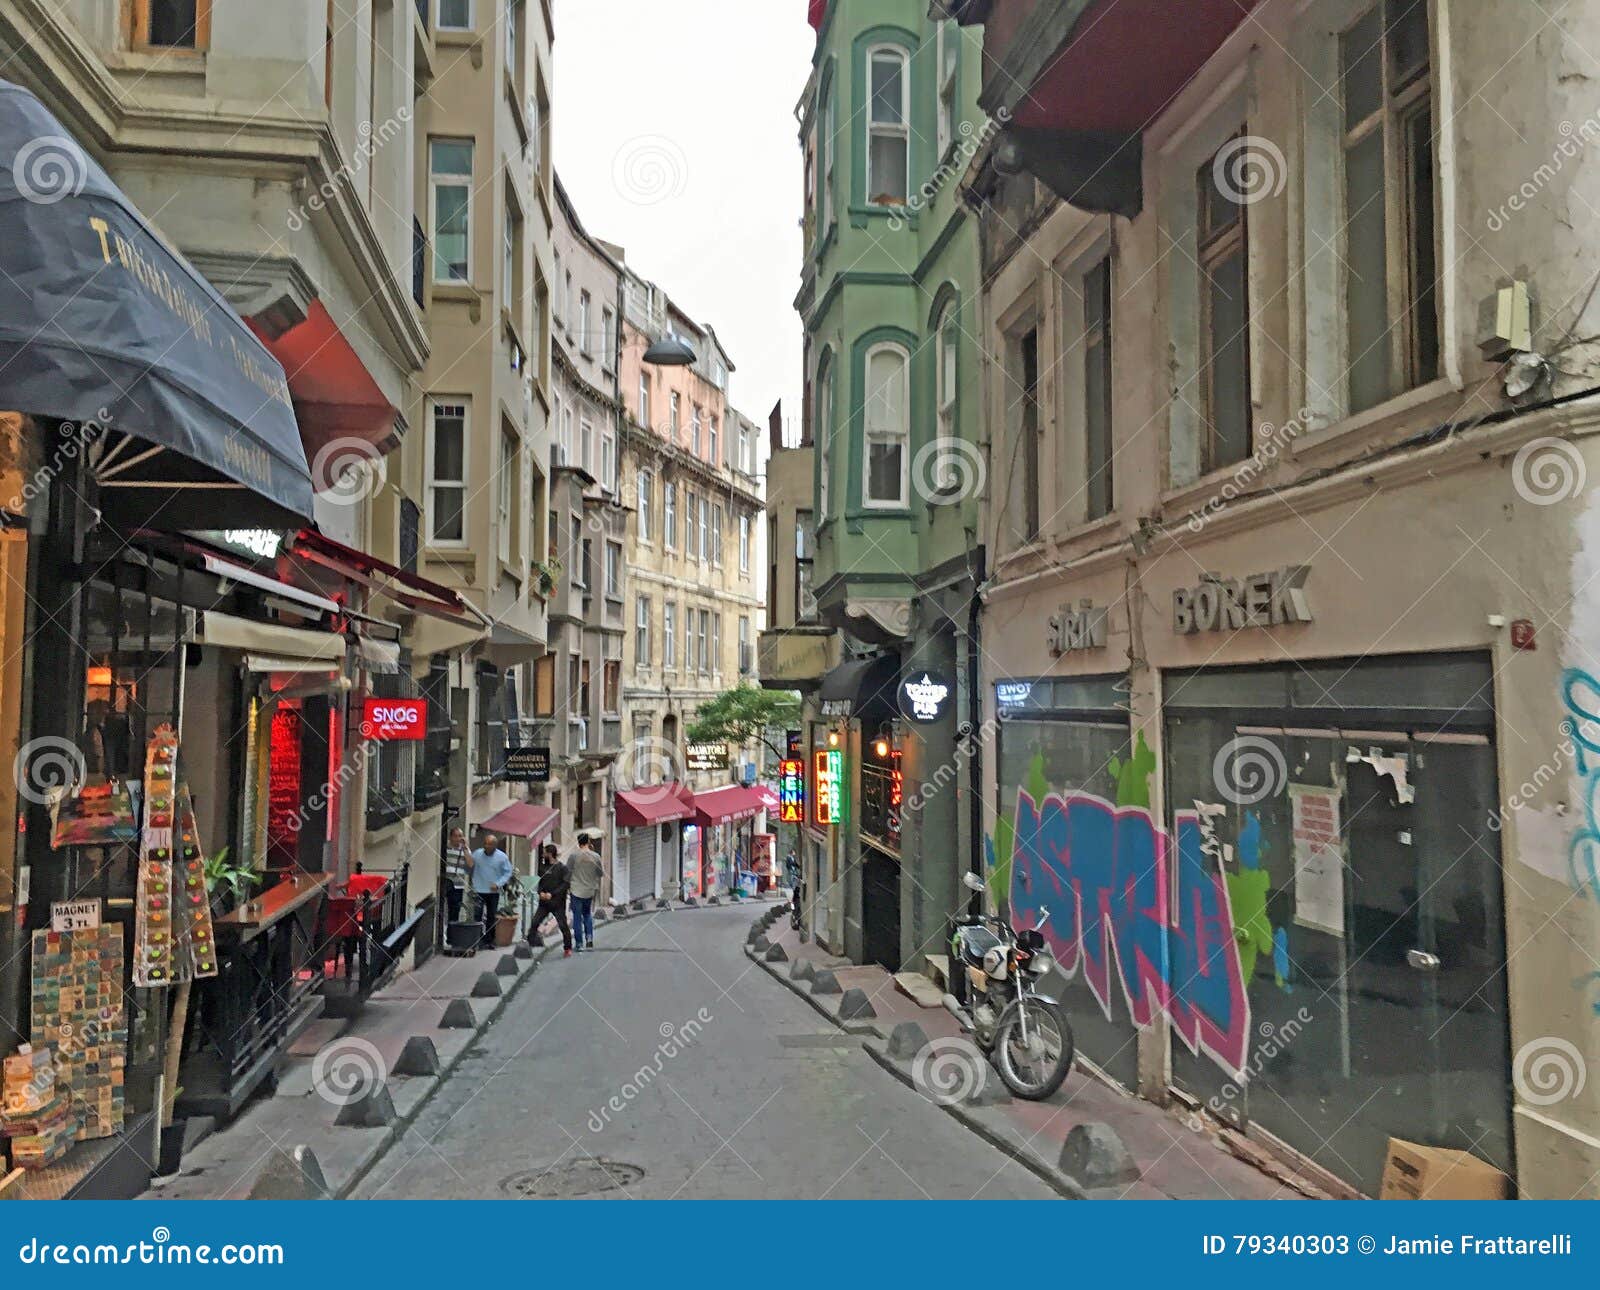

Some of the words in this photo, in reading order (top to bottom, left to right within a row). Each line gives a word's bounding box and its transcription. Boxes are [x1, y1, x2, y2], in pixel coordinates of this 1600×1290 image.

[1171, 565, 1313, 635] BÖREK
[372, 706, 418, 723] SNOG
[785, 761, 798, 820] SENA
[55, 904, 96, 917] MAGNET
[64, 918, 73, 929] 3
[76, 919, 90, 928] TL
